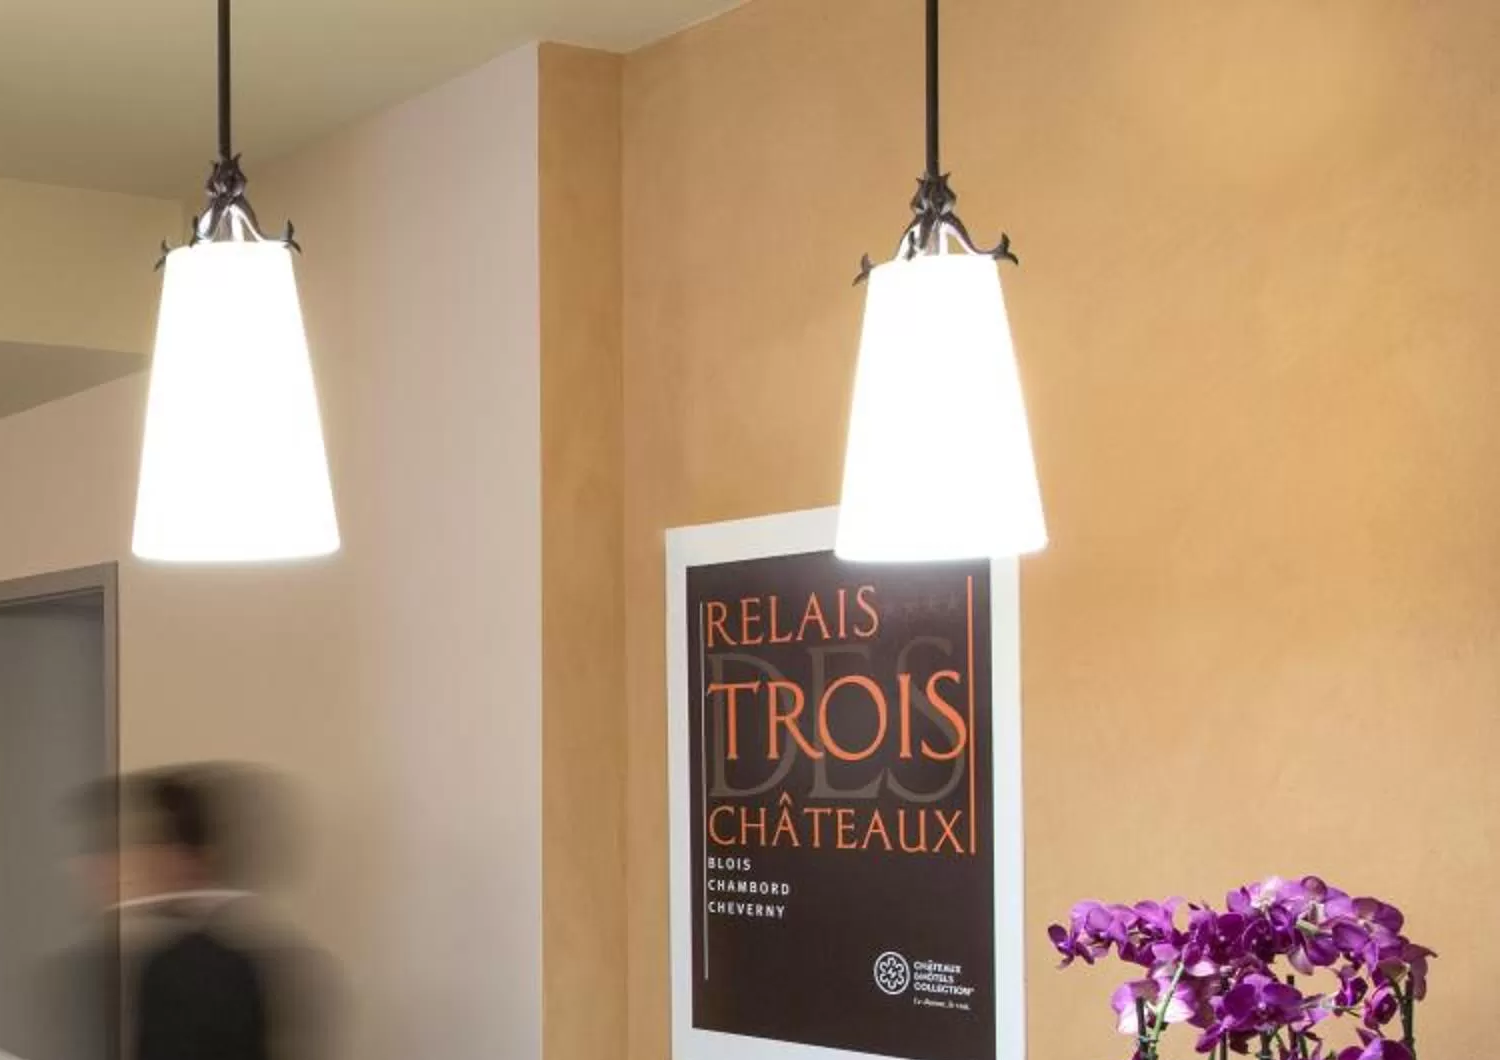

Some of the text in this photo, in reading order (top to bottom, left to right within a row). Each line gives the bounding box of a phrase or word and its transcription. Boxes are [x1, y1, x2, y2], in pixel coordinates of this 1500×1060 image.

[707, 585, 879, 647] RELAIS
[707, 669, 968, 761] TROIS
[707, 636, 966, 803] DES
[708, 791, 965, 853] CHÂTEAUX
[707, 857, 752, 871] BLOIS
[707, 879, 790, 896] CHAMBORD
[707, 901, 785, 919] CHEVERNY
